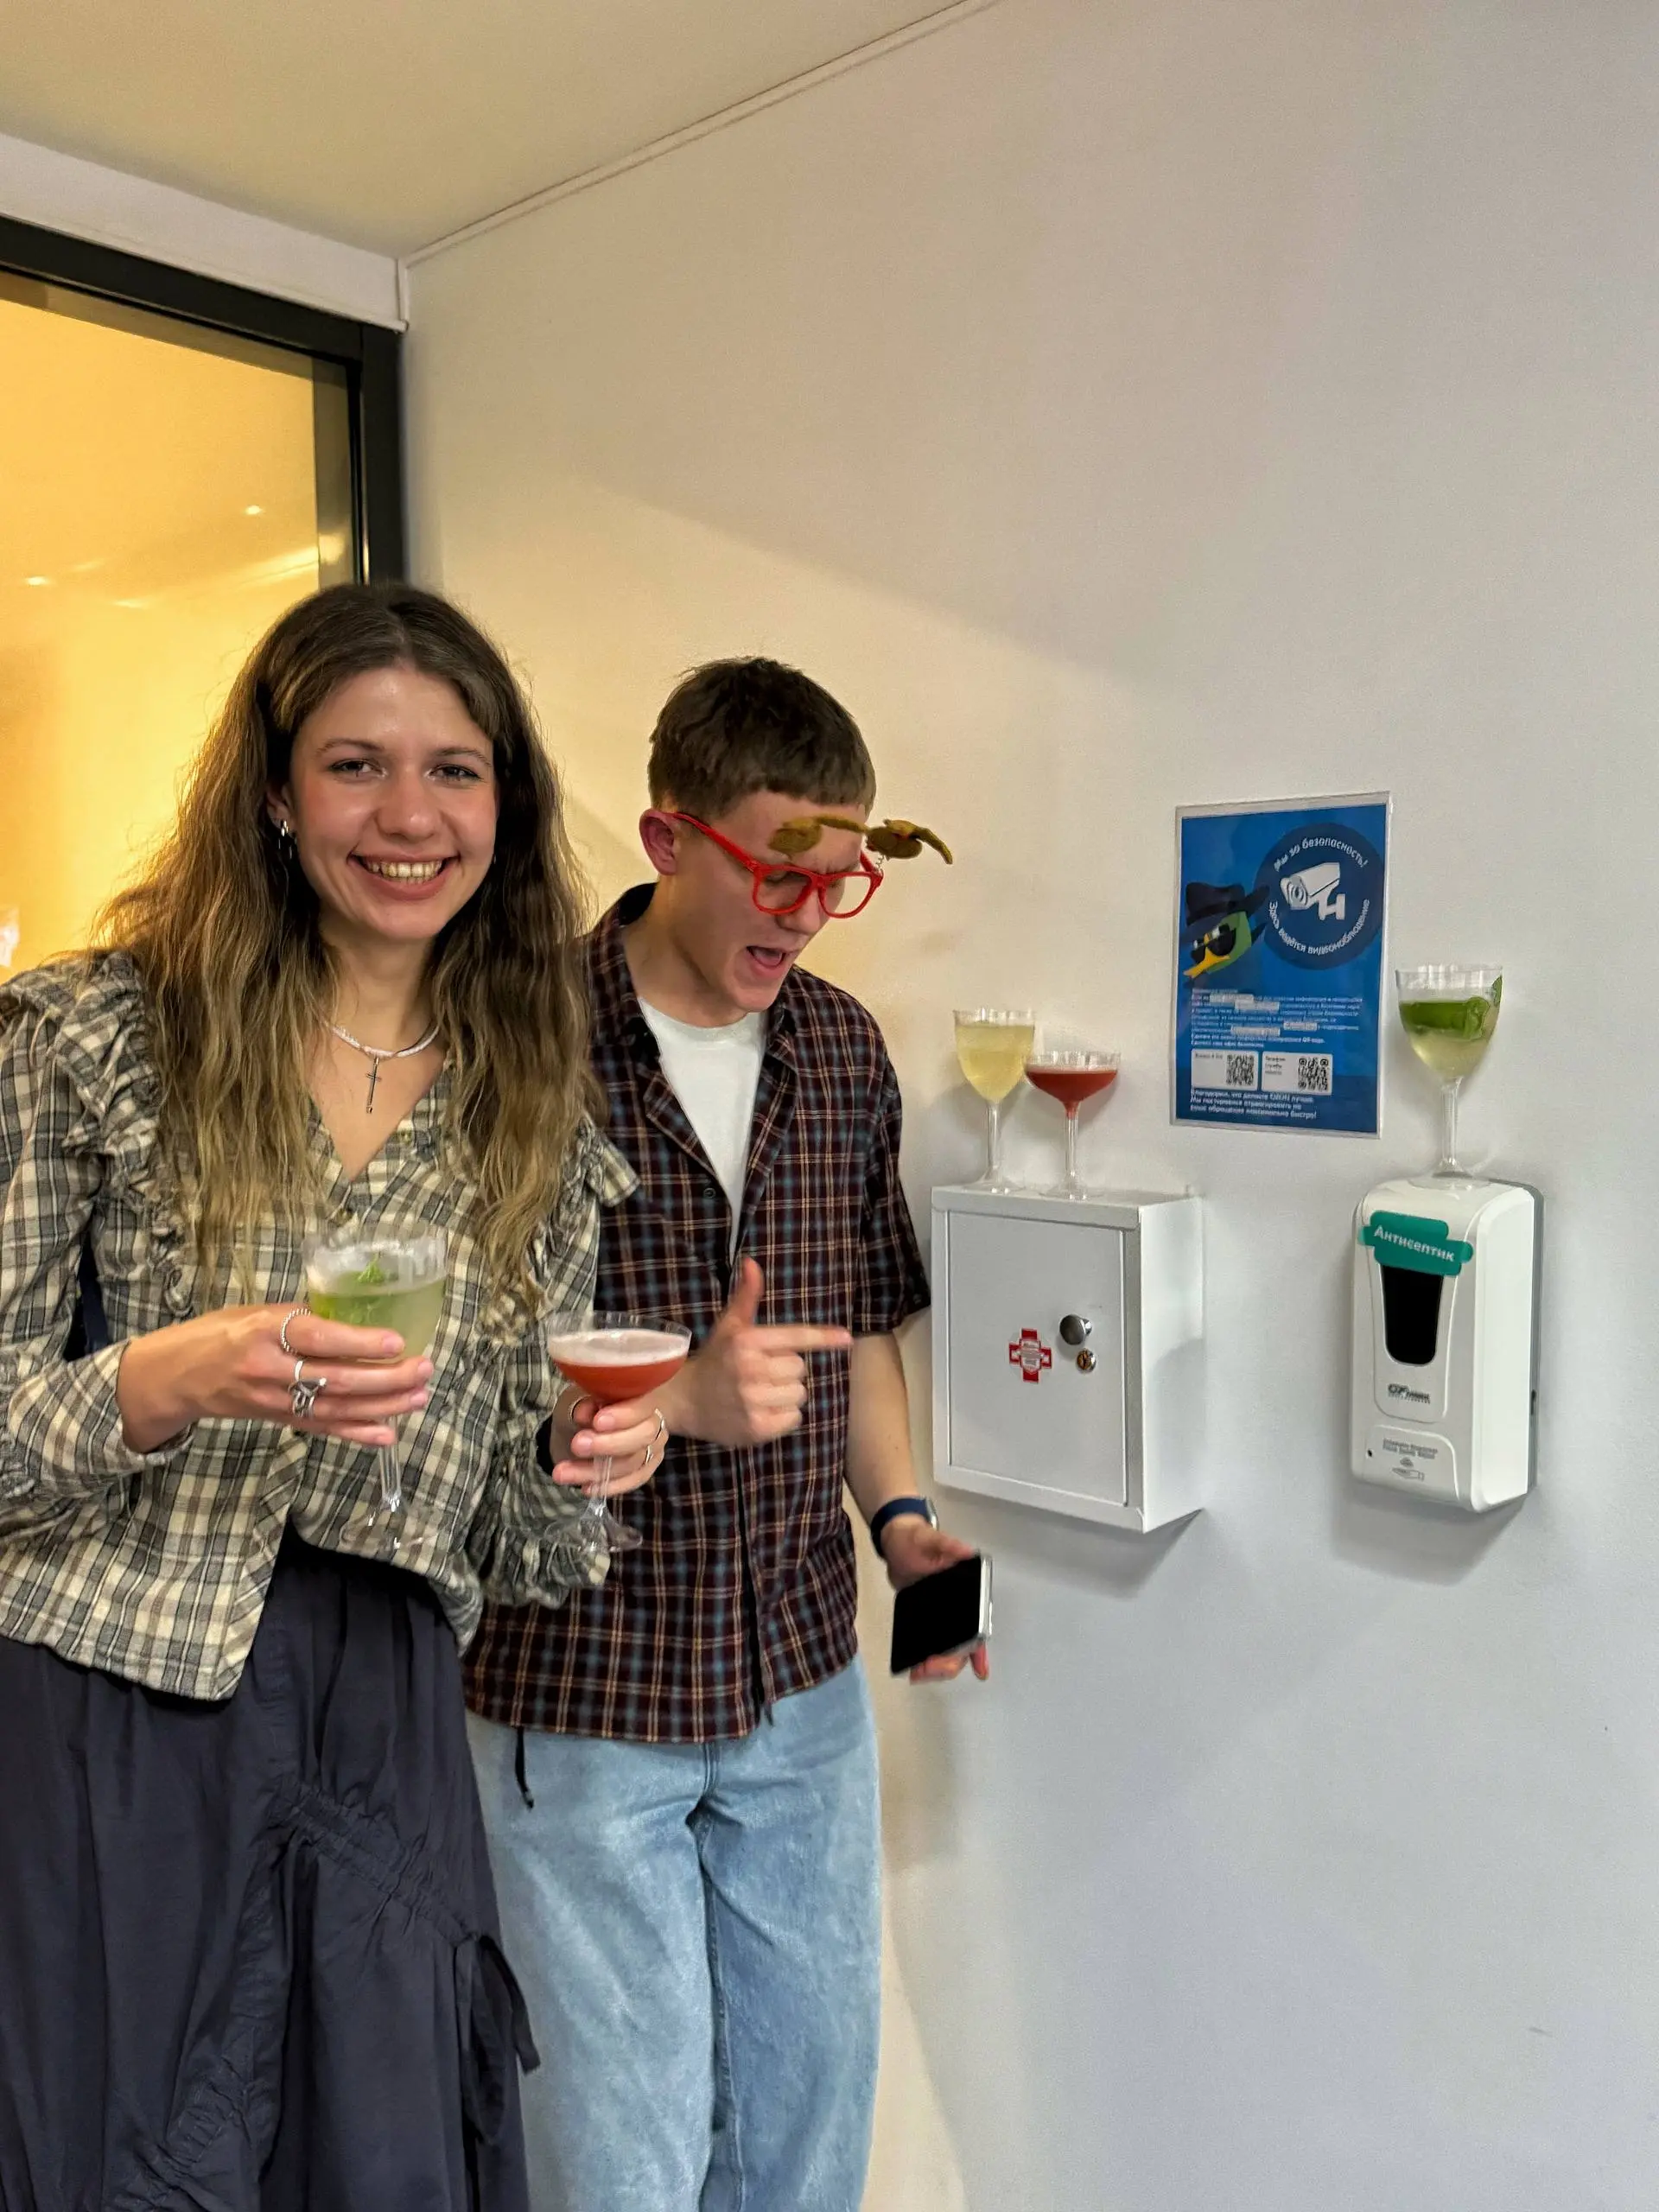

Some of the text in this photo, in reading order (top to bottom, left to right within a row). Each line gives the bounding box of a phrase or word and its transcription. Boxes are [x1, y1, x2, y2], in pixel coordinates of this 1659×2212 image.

[1301, 836, 1370, 868] безопасность!
[1307, 899, 1370, 957] видеонаблюдение
[1374, 1224, 1455, 1262] Антисептик
